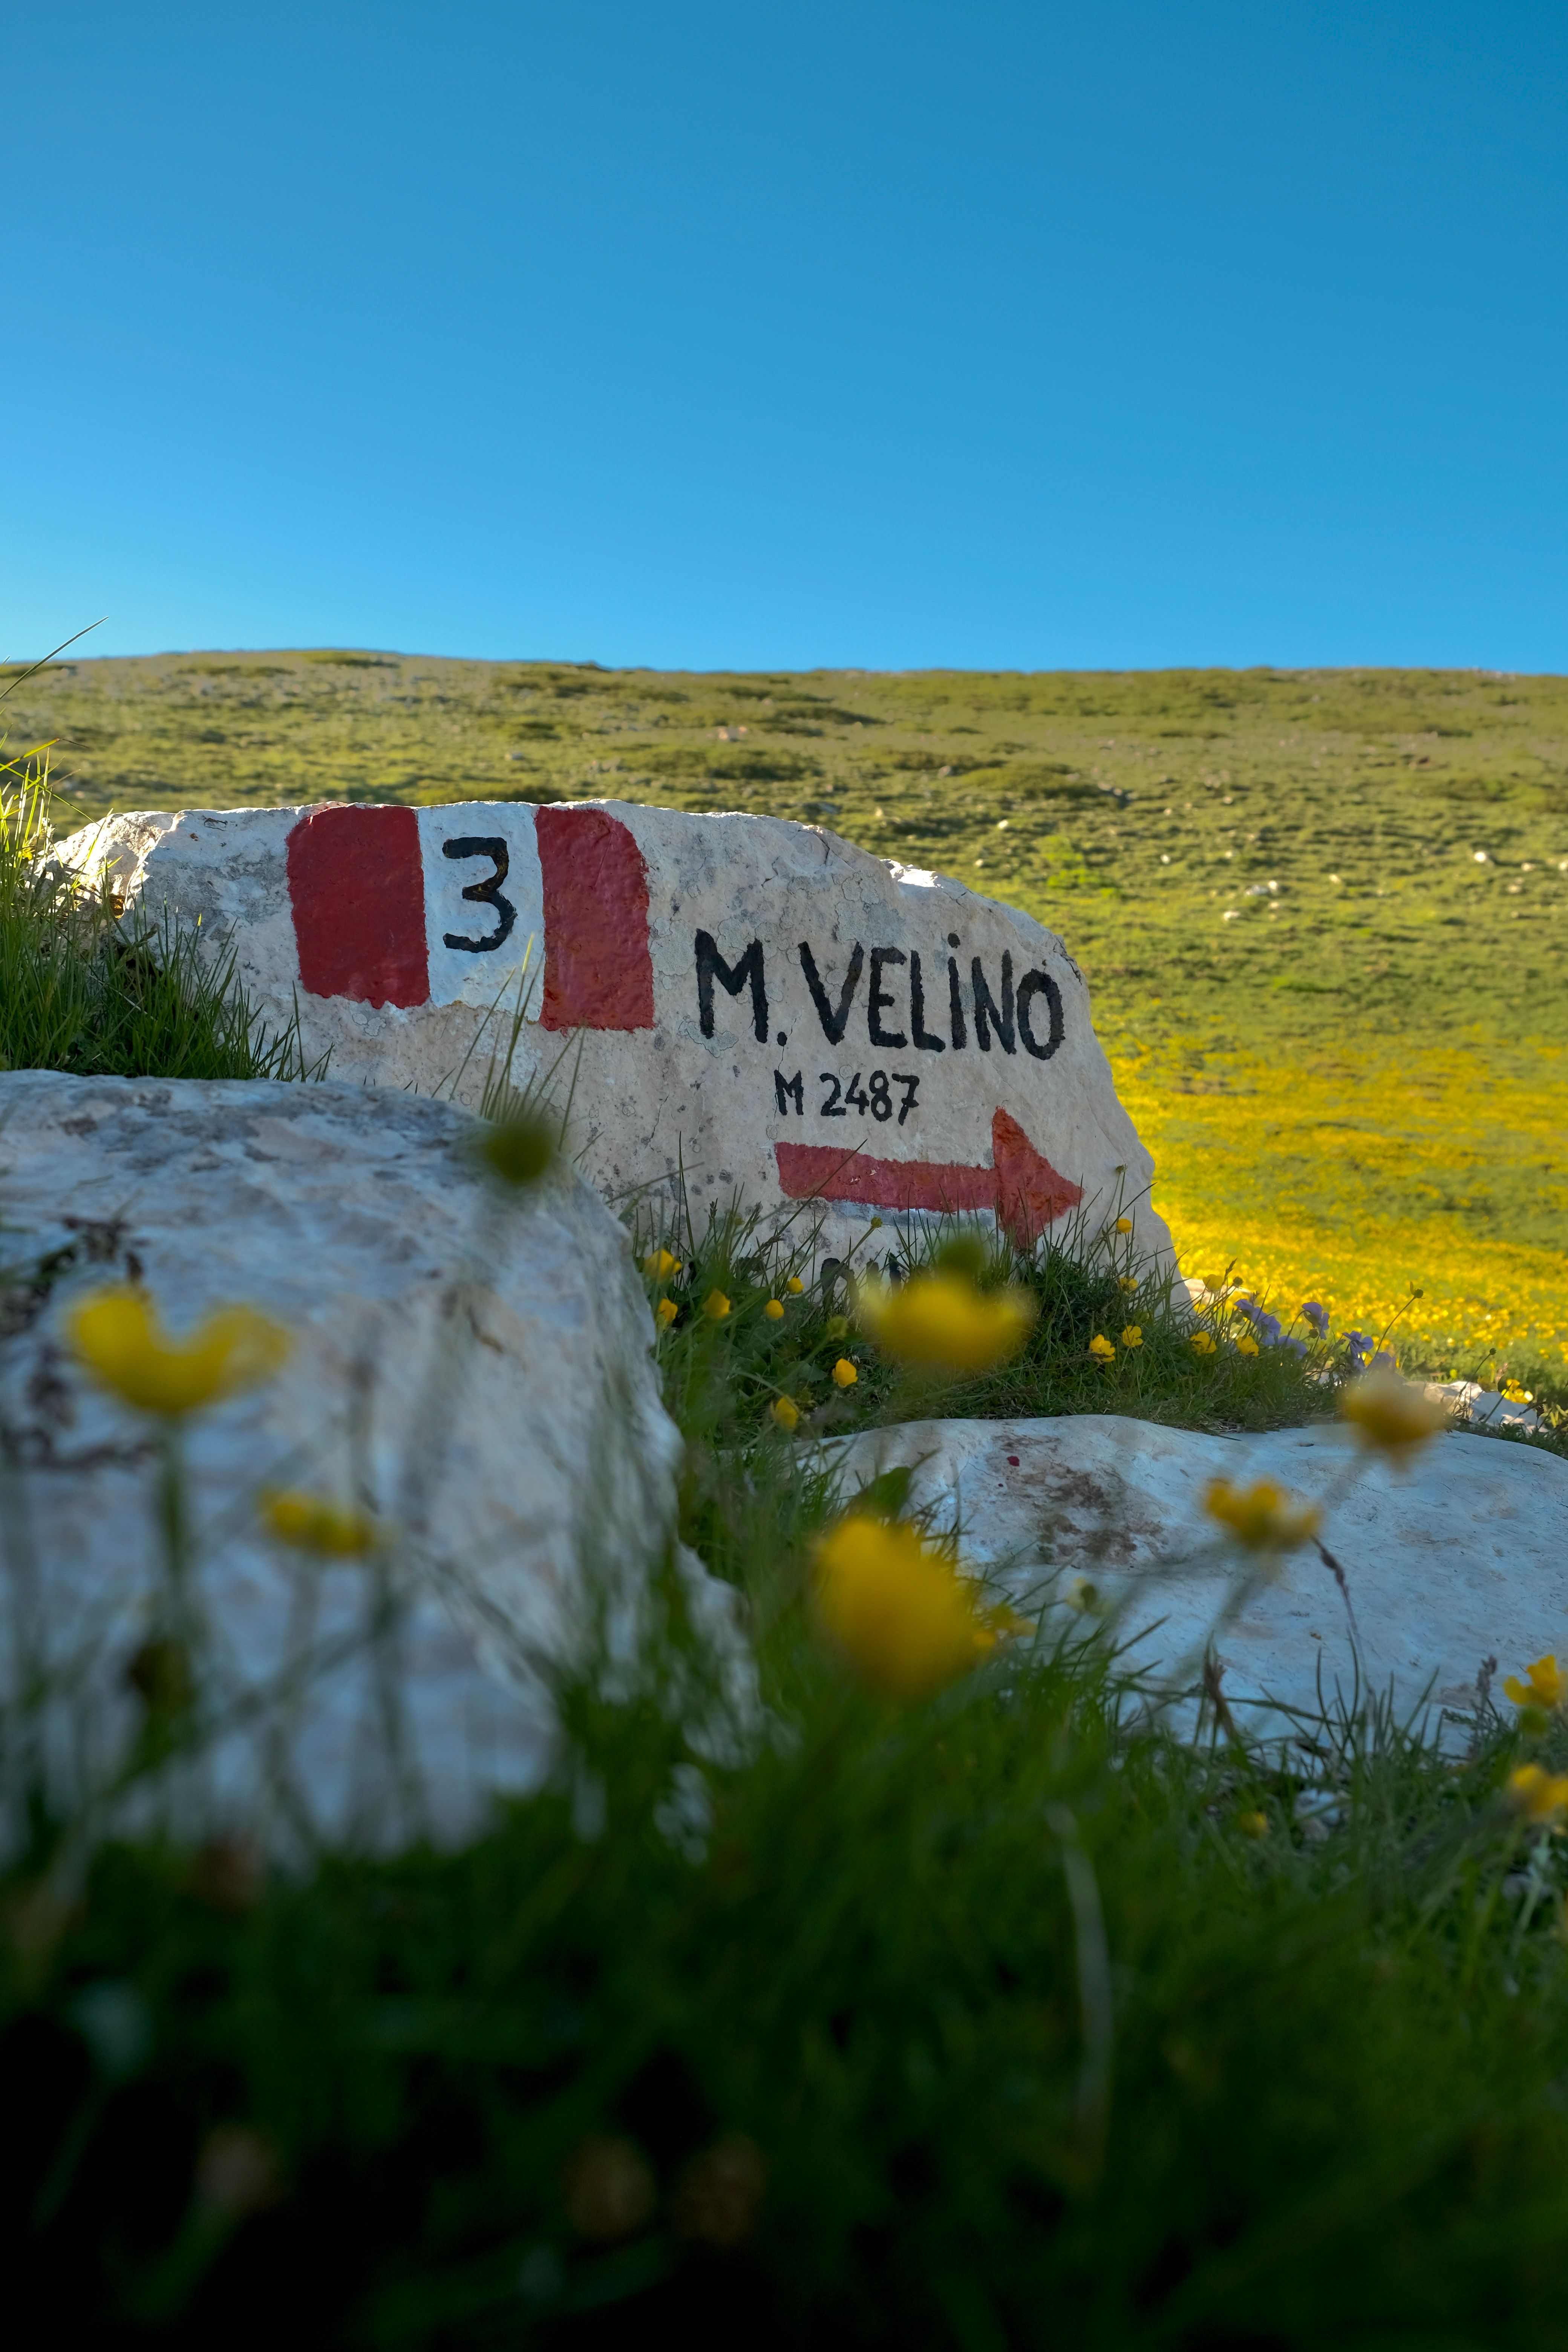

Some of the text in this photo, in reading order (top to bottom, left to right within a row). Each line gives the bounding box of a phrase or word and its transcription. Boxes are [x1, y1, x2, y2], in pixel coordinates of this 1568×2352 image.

[442, 836, 517, 954] 3
[694, 928, 788, 1047] M.
[774, 1069, 920, 1126] M 2487
